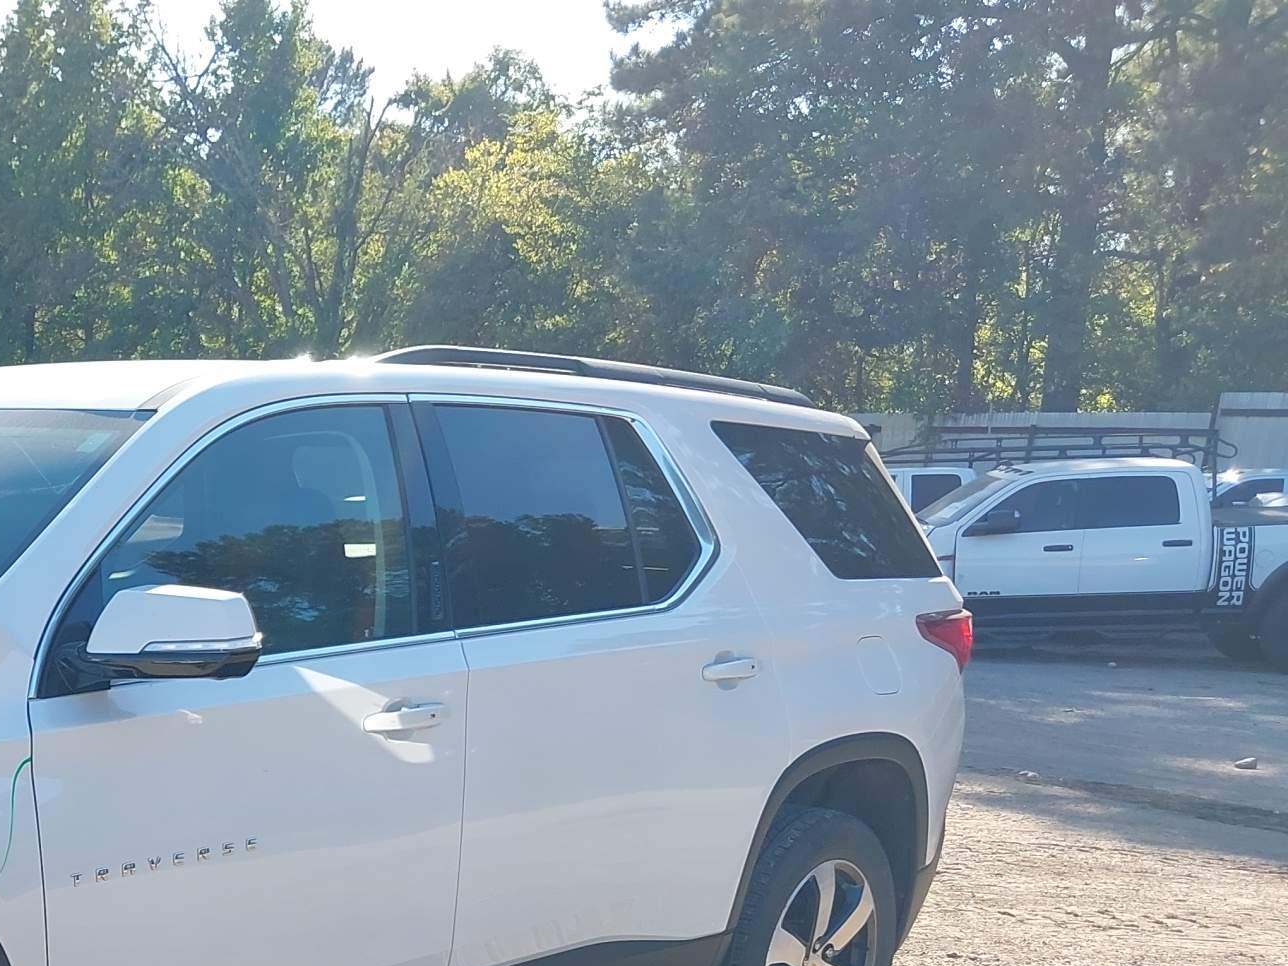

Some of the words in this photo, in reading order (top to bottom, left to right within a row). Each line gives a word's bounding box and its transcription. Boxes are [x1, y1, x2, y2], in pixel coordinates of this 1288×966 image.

[1216, 527, 1236, 606] WAGON
[1230, 527, 1249, 606] POWER
[70, 837, 257, 888] TRAVERSE
